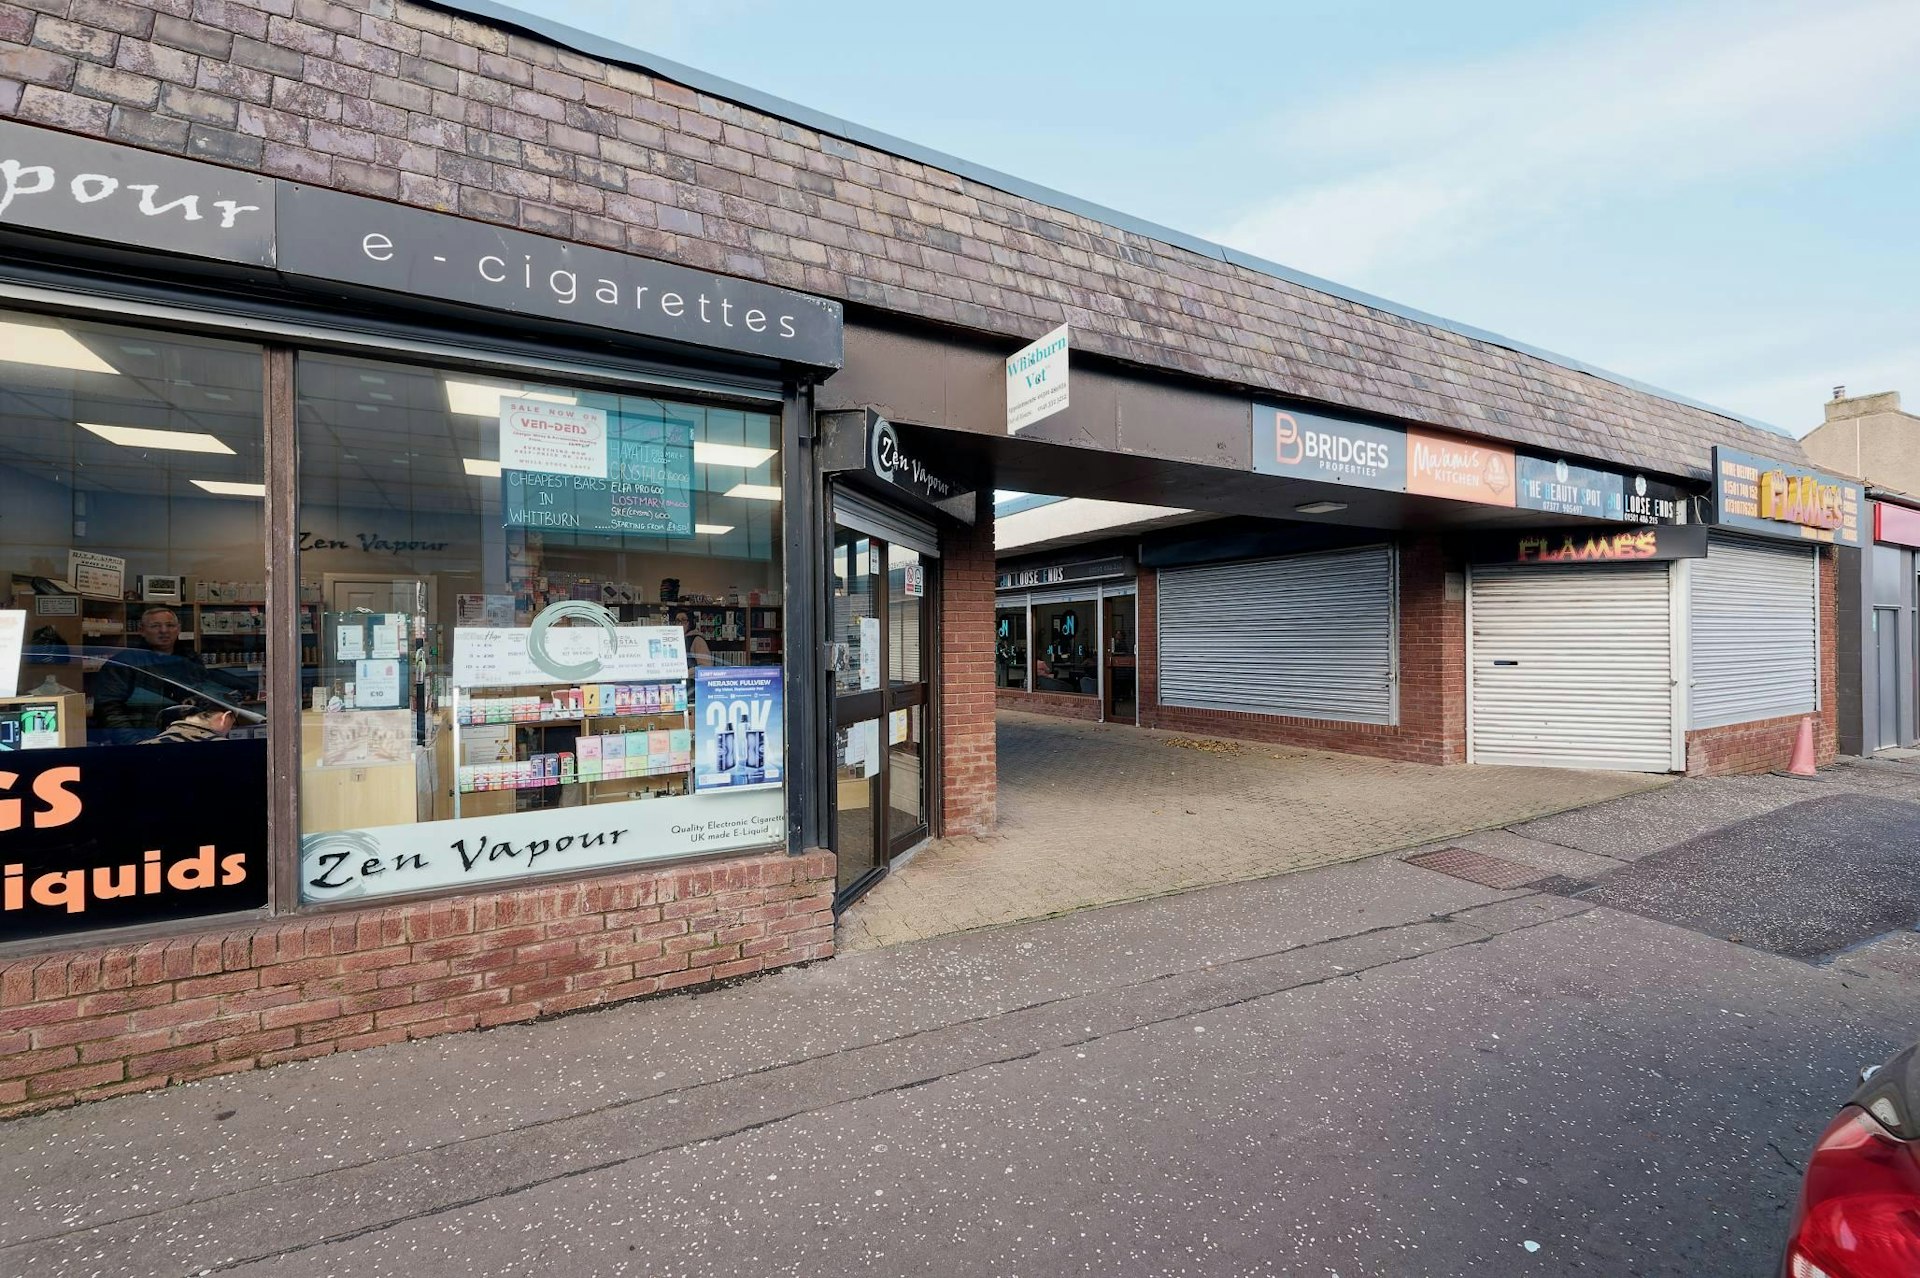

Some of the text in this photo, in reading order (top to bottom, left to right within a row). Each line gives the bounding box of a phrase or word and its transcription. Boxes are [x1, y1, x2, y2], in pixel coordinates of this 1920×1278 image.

[1305, 430, 1389, 469] BRIDGES
[881, 436, 949, 495] Zen Vapour
[1319, 460, 1377, 477] PROPERTIES
[510, 473, 607, 491] CHEAPEST BARS
[540, 491, 554, 505] IN
[1521, 477, 1601, 507] THE BEAUTY SPOT
[612, 495, 641, 507] LOST
[641, 497, 665, 509] MARY
[1625, 494, 1650, 516] LOOSE
[1655, 498, 1674, 519] ENDS
[509, 509, 580, 527] WHITBURN
[299, 531, 449, 555] Zen Vapour
[1518, 530, 1657, 560] FLAMES
[1015, 569, 1039, 587] LOOSE
[1043, 567, 1064, 583] ENDS
[739, 679, 772, 687] FULLVIEW
[671, 824, 704, 835] Quality
[707, 819, 747, 831] Electronic
[690, 824, 768, 843] UK made E-Liquid
[310, 829, 629, 889] Zen Vapour
